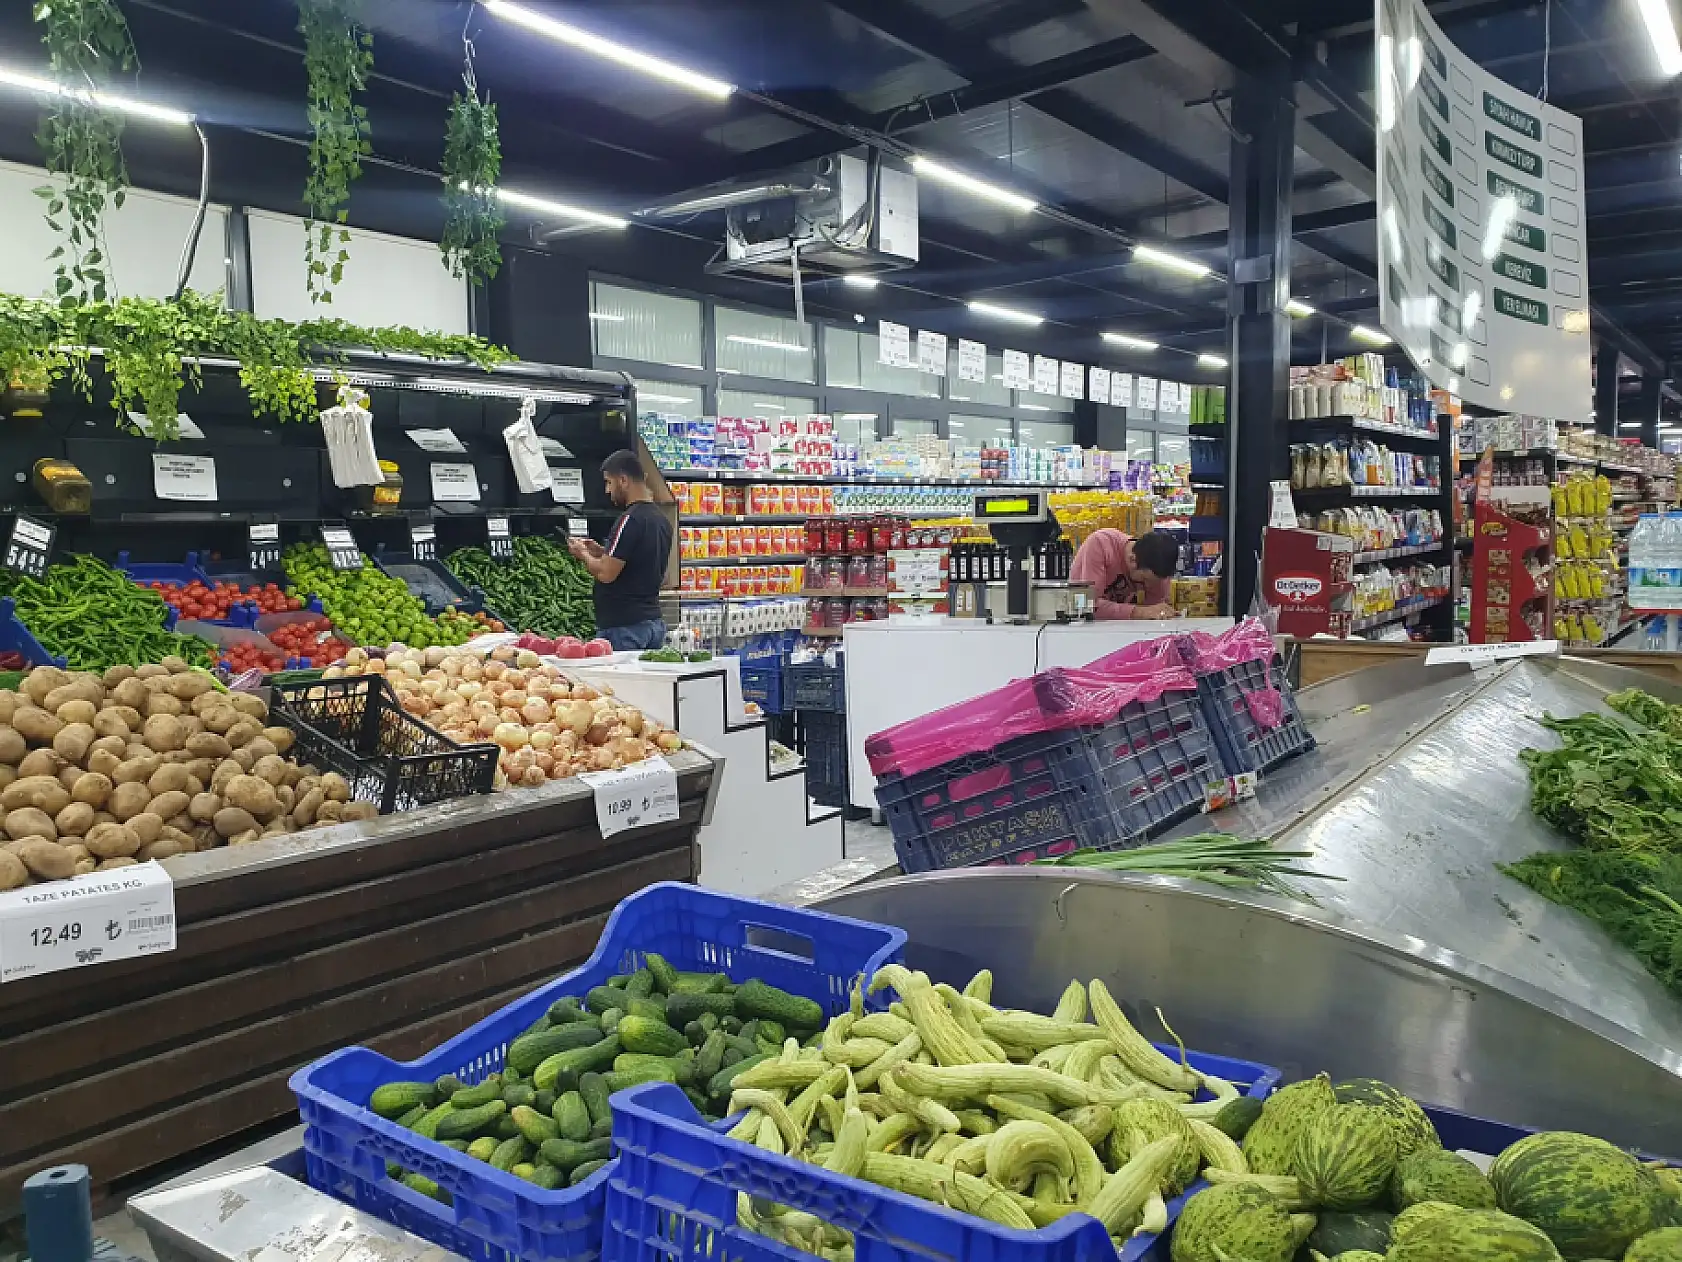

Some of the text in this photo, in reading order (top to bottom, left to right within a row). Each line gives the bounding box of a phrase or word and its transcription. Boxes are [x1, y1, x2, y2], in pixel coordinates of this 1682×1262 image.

[21, 892, 59, 904] TAZE
[60, 882, 121, 898] PATATES
[30, 921, 83, 948] 12,49
